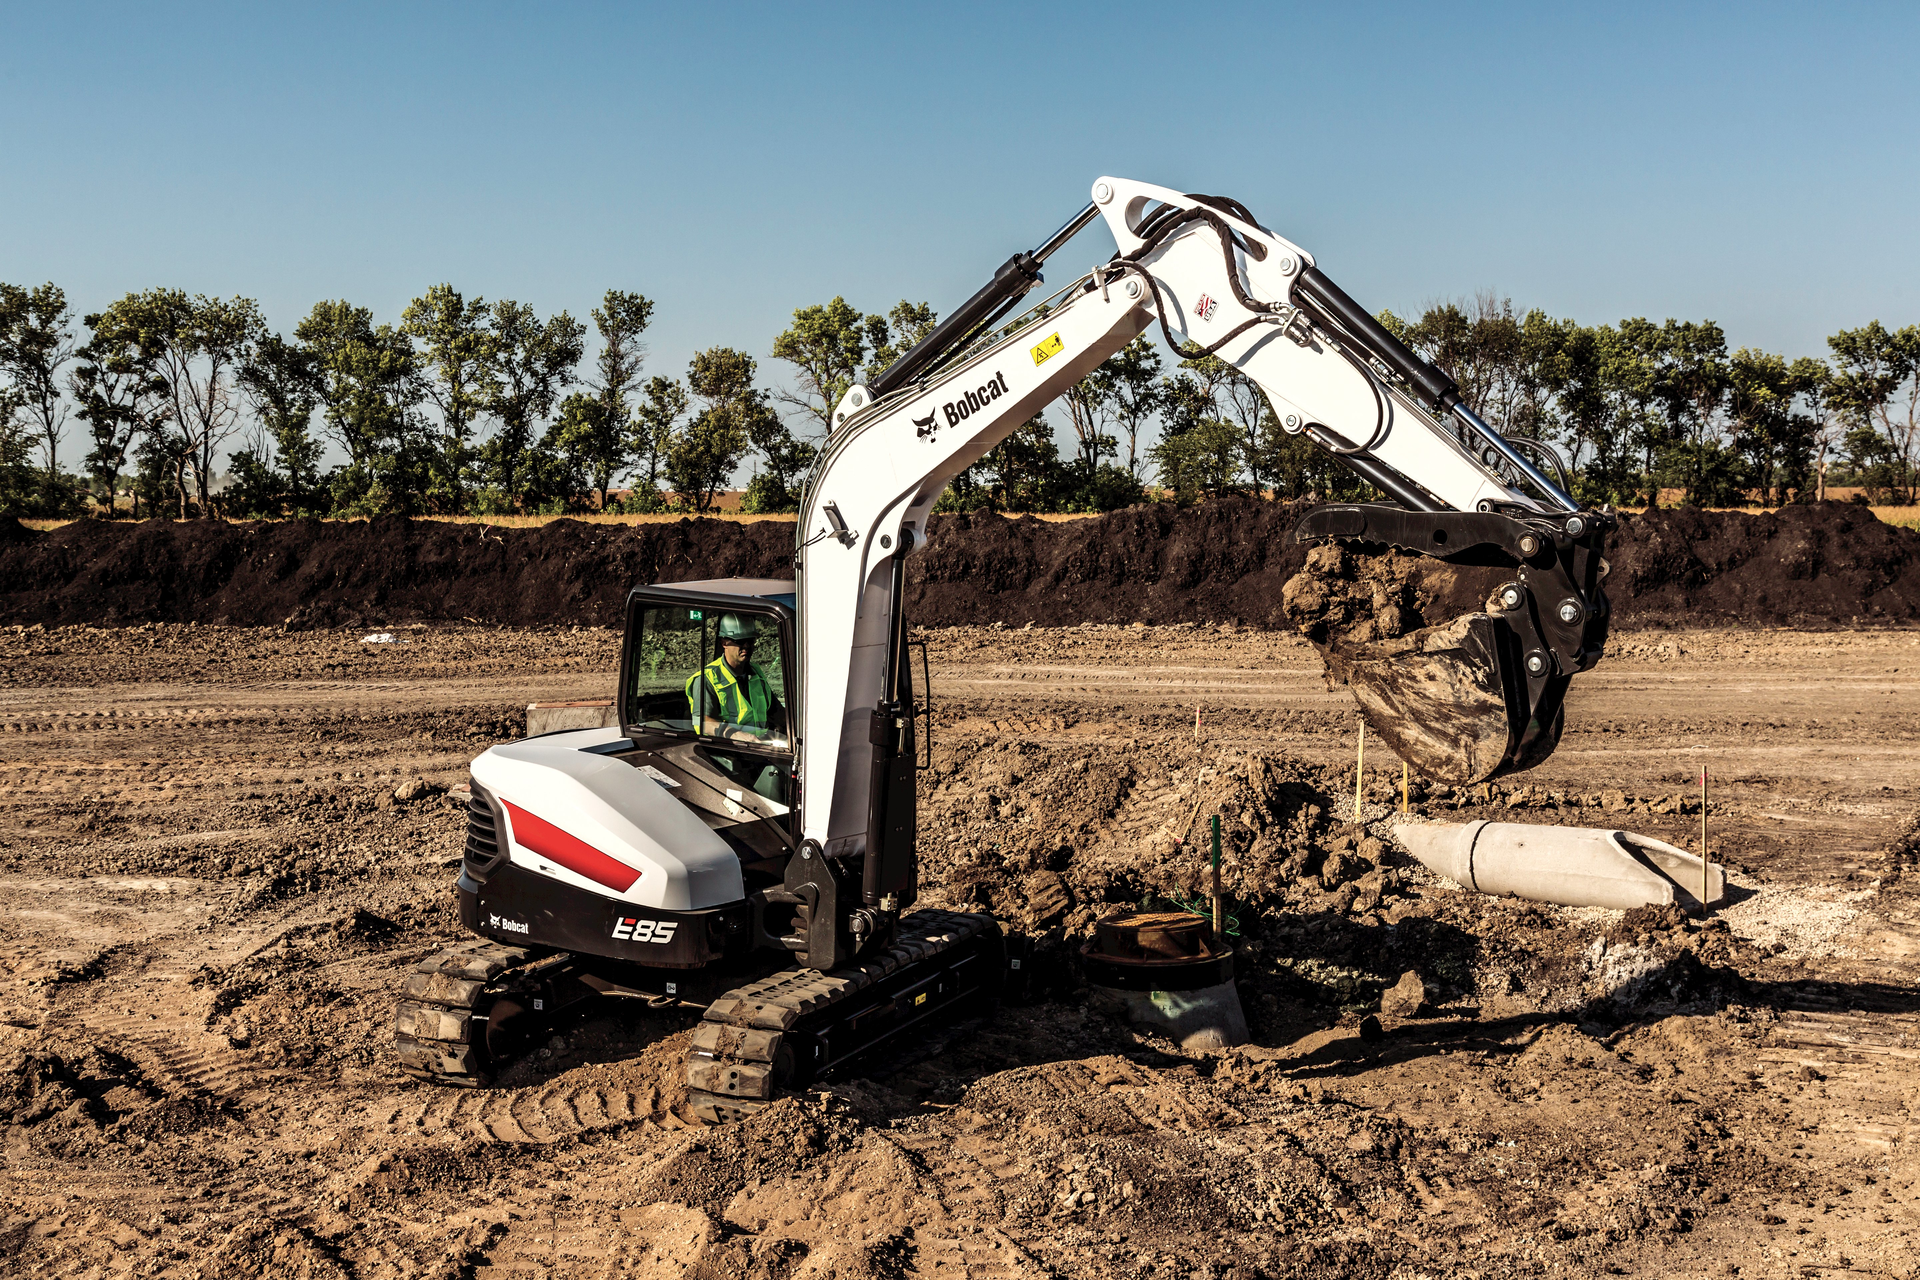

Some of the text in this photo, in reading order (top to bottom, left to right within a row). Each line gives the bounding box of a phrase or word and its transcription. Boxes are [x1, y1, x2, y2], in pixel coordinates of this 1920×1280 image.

[942, 370, 1009, 428] Bobcat
[502, 918, 529, 934] Bobcat
[611, 916, 678, 944] E85
